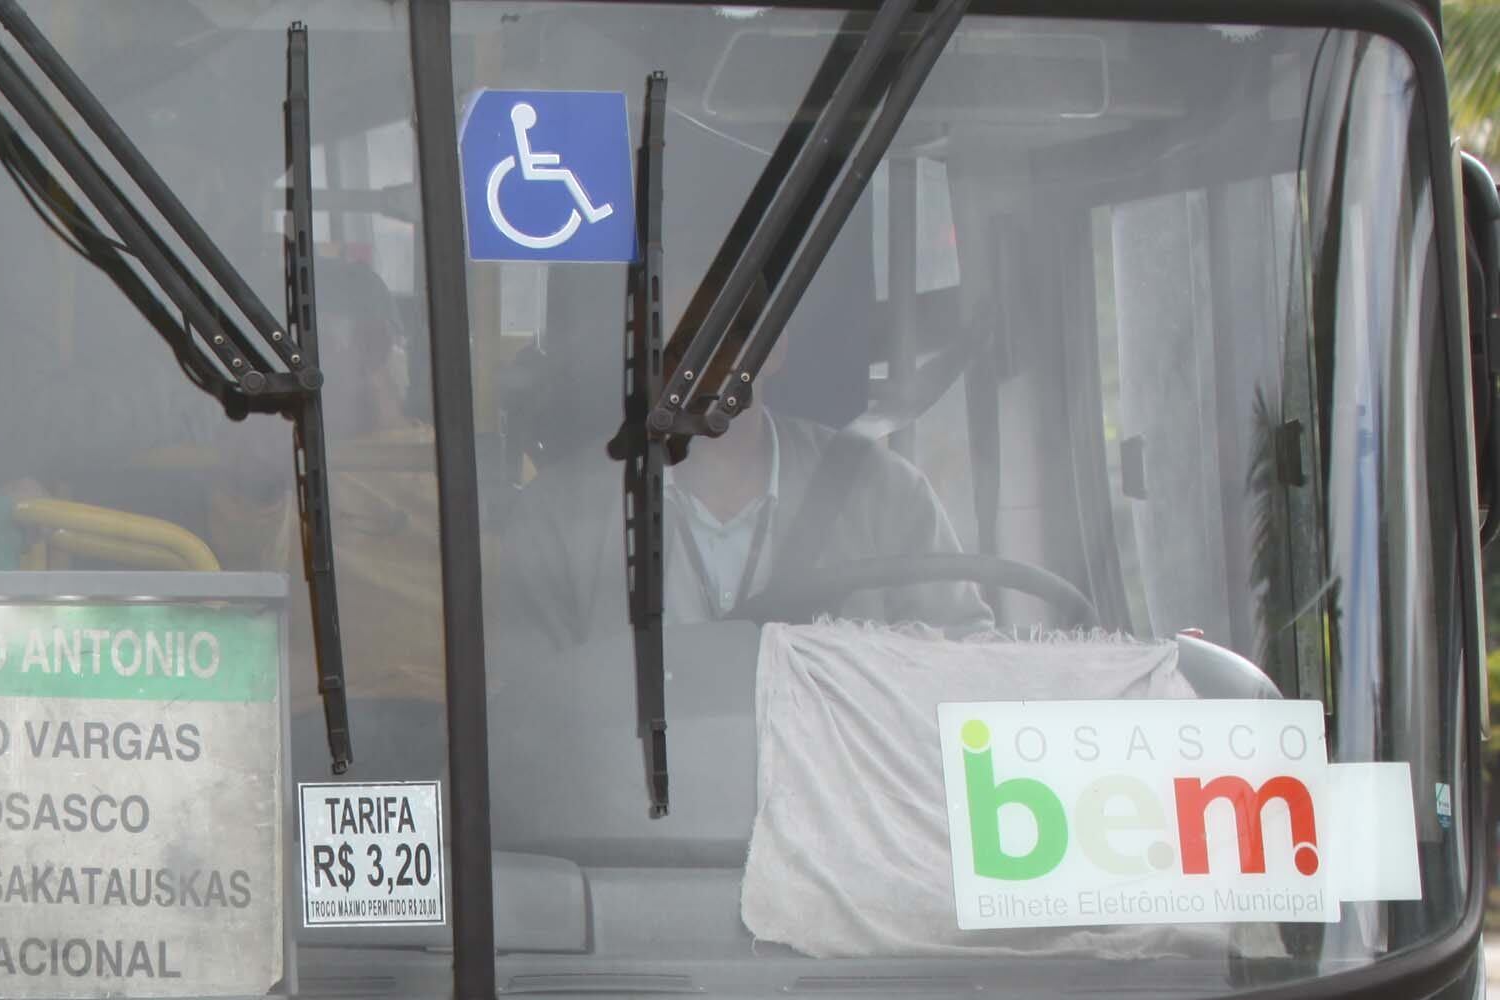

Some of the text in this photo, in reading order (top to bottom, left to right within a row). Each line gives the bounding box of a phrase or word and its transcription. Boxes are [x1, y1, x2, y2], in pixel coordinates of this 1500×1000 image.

[21, 627, 220, 679] ANTONIO
[25, 719, 202, 762] VARGAS
[1014, 724, 1309, 763] OSASCO
[325, 796, 416, 834] TARIFA
[313, 841, 432, 894] R$ 3,20
[311, 901, 336, 917] TROCO
[368, 899, 406, 917] PERMITIDO
[978, 888, 1324, 919] Bilhete Eletrônico Municipal
